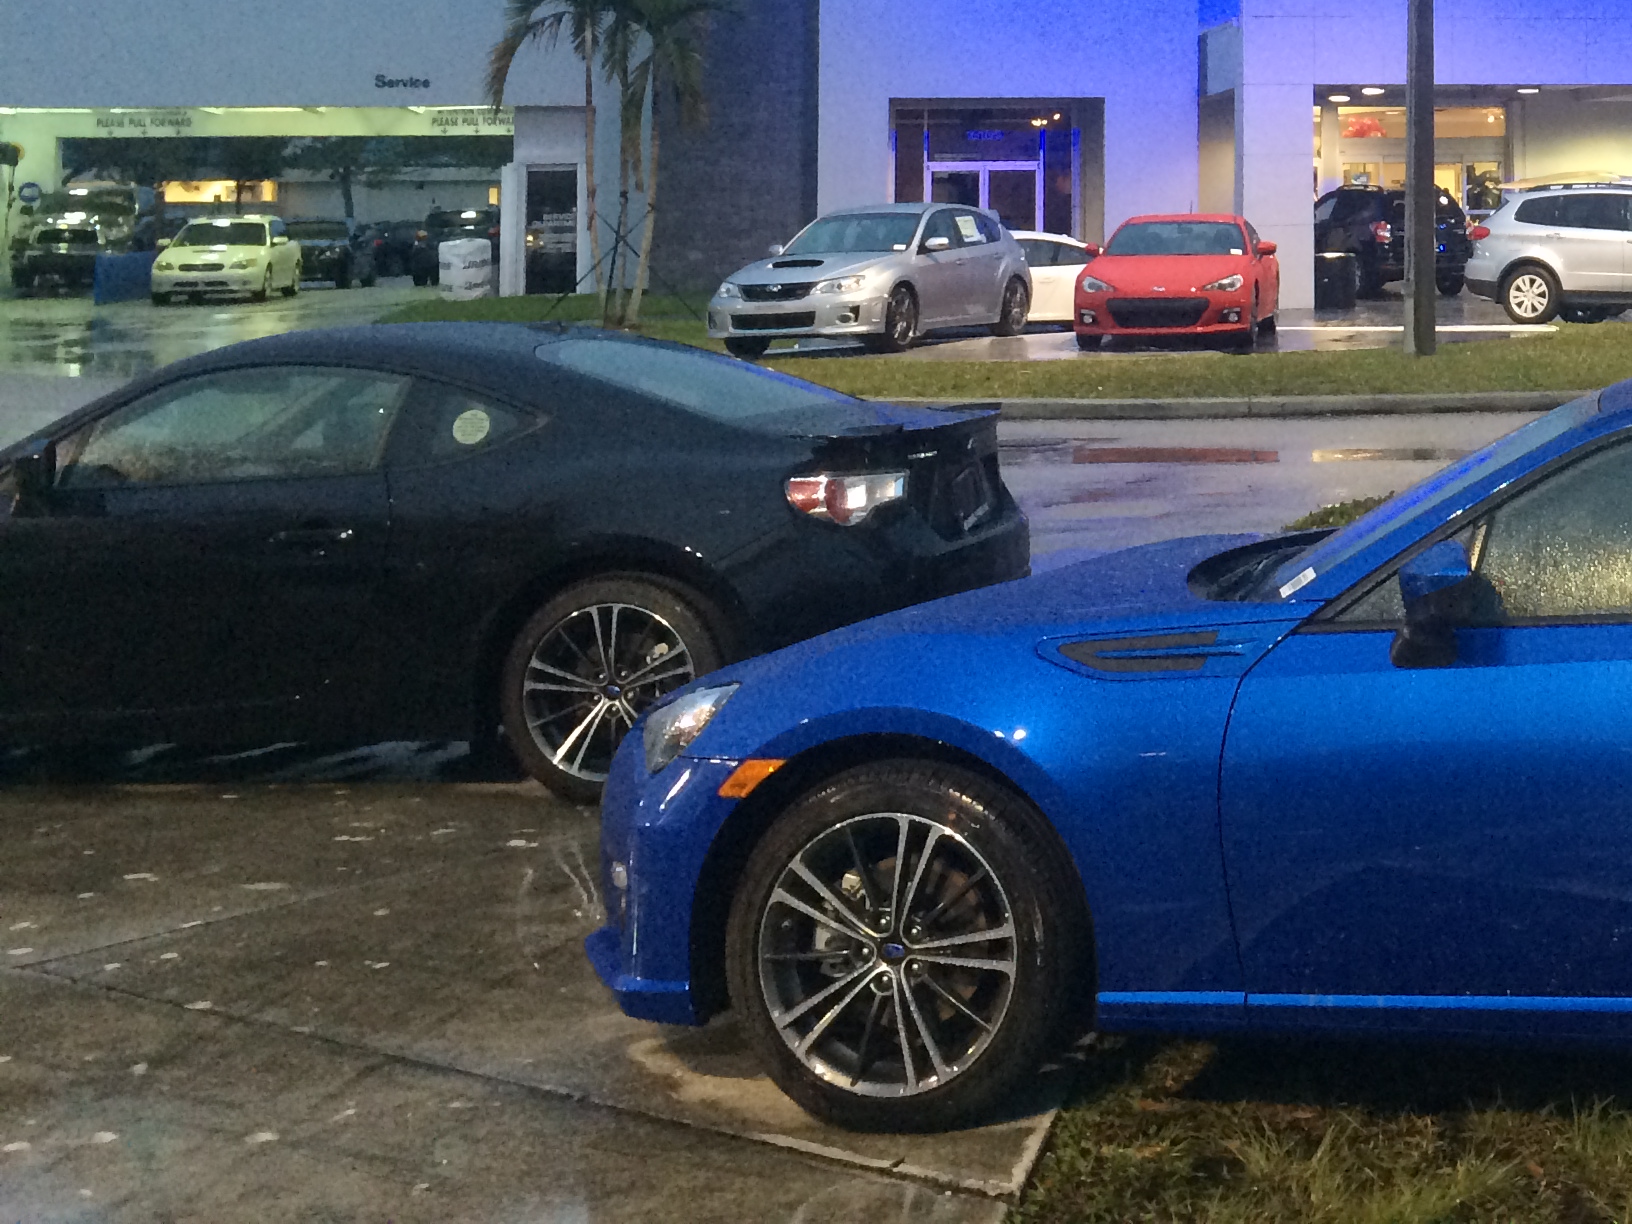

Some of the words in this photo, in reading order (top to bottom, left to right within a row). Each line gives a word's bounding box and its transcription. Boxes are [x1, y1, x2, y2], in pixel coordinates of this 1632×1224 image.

[375, 74, 430, 88] Service
[97, 117, 124, 128] PLEASE
[129, 117, 146, 128] PULL
[150, 117, 192, 128] FORWARD
[431, 117, 459, 126] PLEASE
[462, 117, 478, 126] PULL
